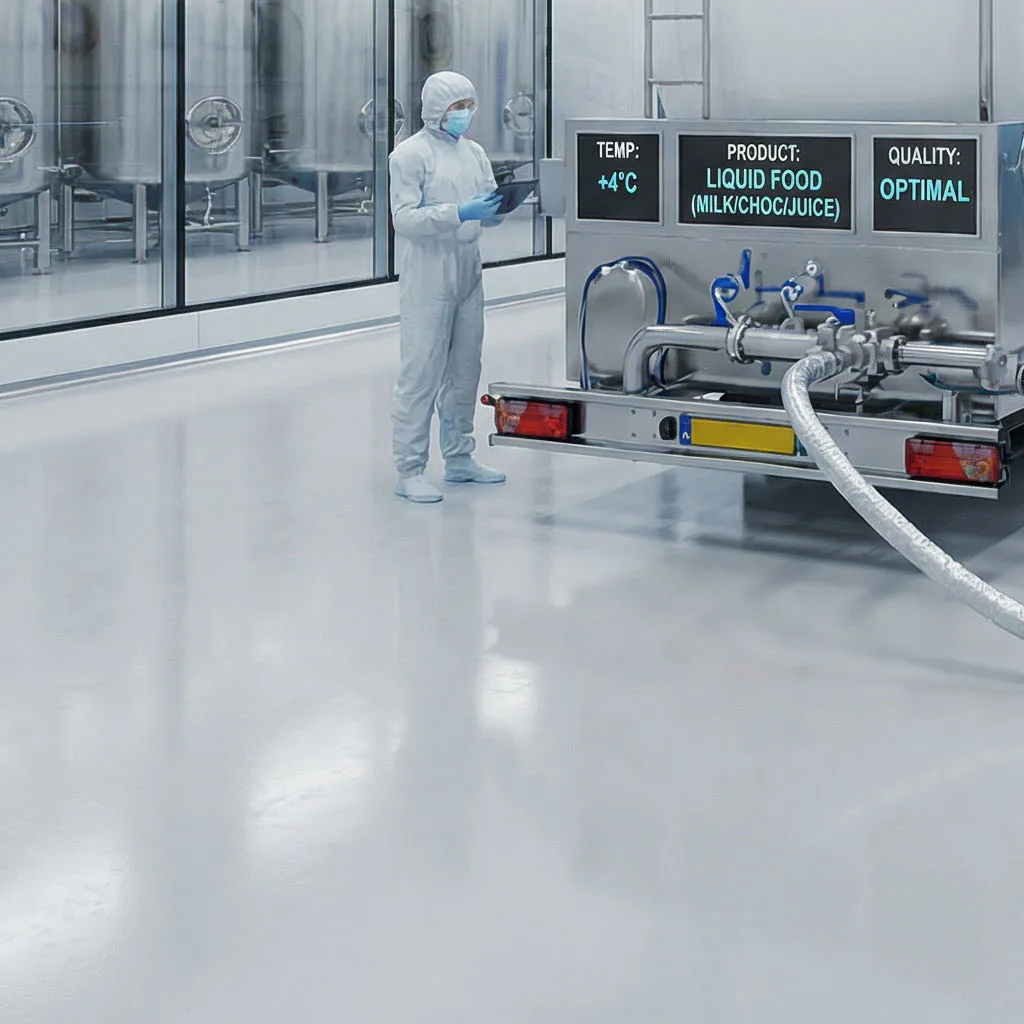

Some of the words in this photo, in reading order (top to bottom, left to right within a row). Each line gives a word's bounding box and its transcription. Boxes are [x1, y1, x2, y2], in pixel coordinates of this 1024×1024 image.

[597, 141, 640, 160] TEMP:
[727, 144, 801, 164] PRODUCT:
[888, 146, 961, 166] QUALITY:
[597, 171, 638, 194] +4°C
[706, 167, 766, 190] LIQUID
[770, 169, 823, 191] FOOD
[879, 178, 970, 203] OPTIMAL
[690, 193, 841, 223] (MILK/CHOC/JUICE)
